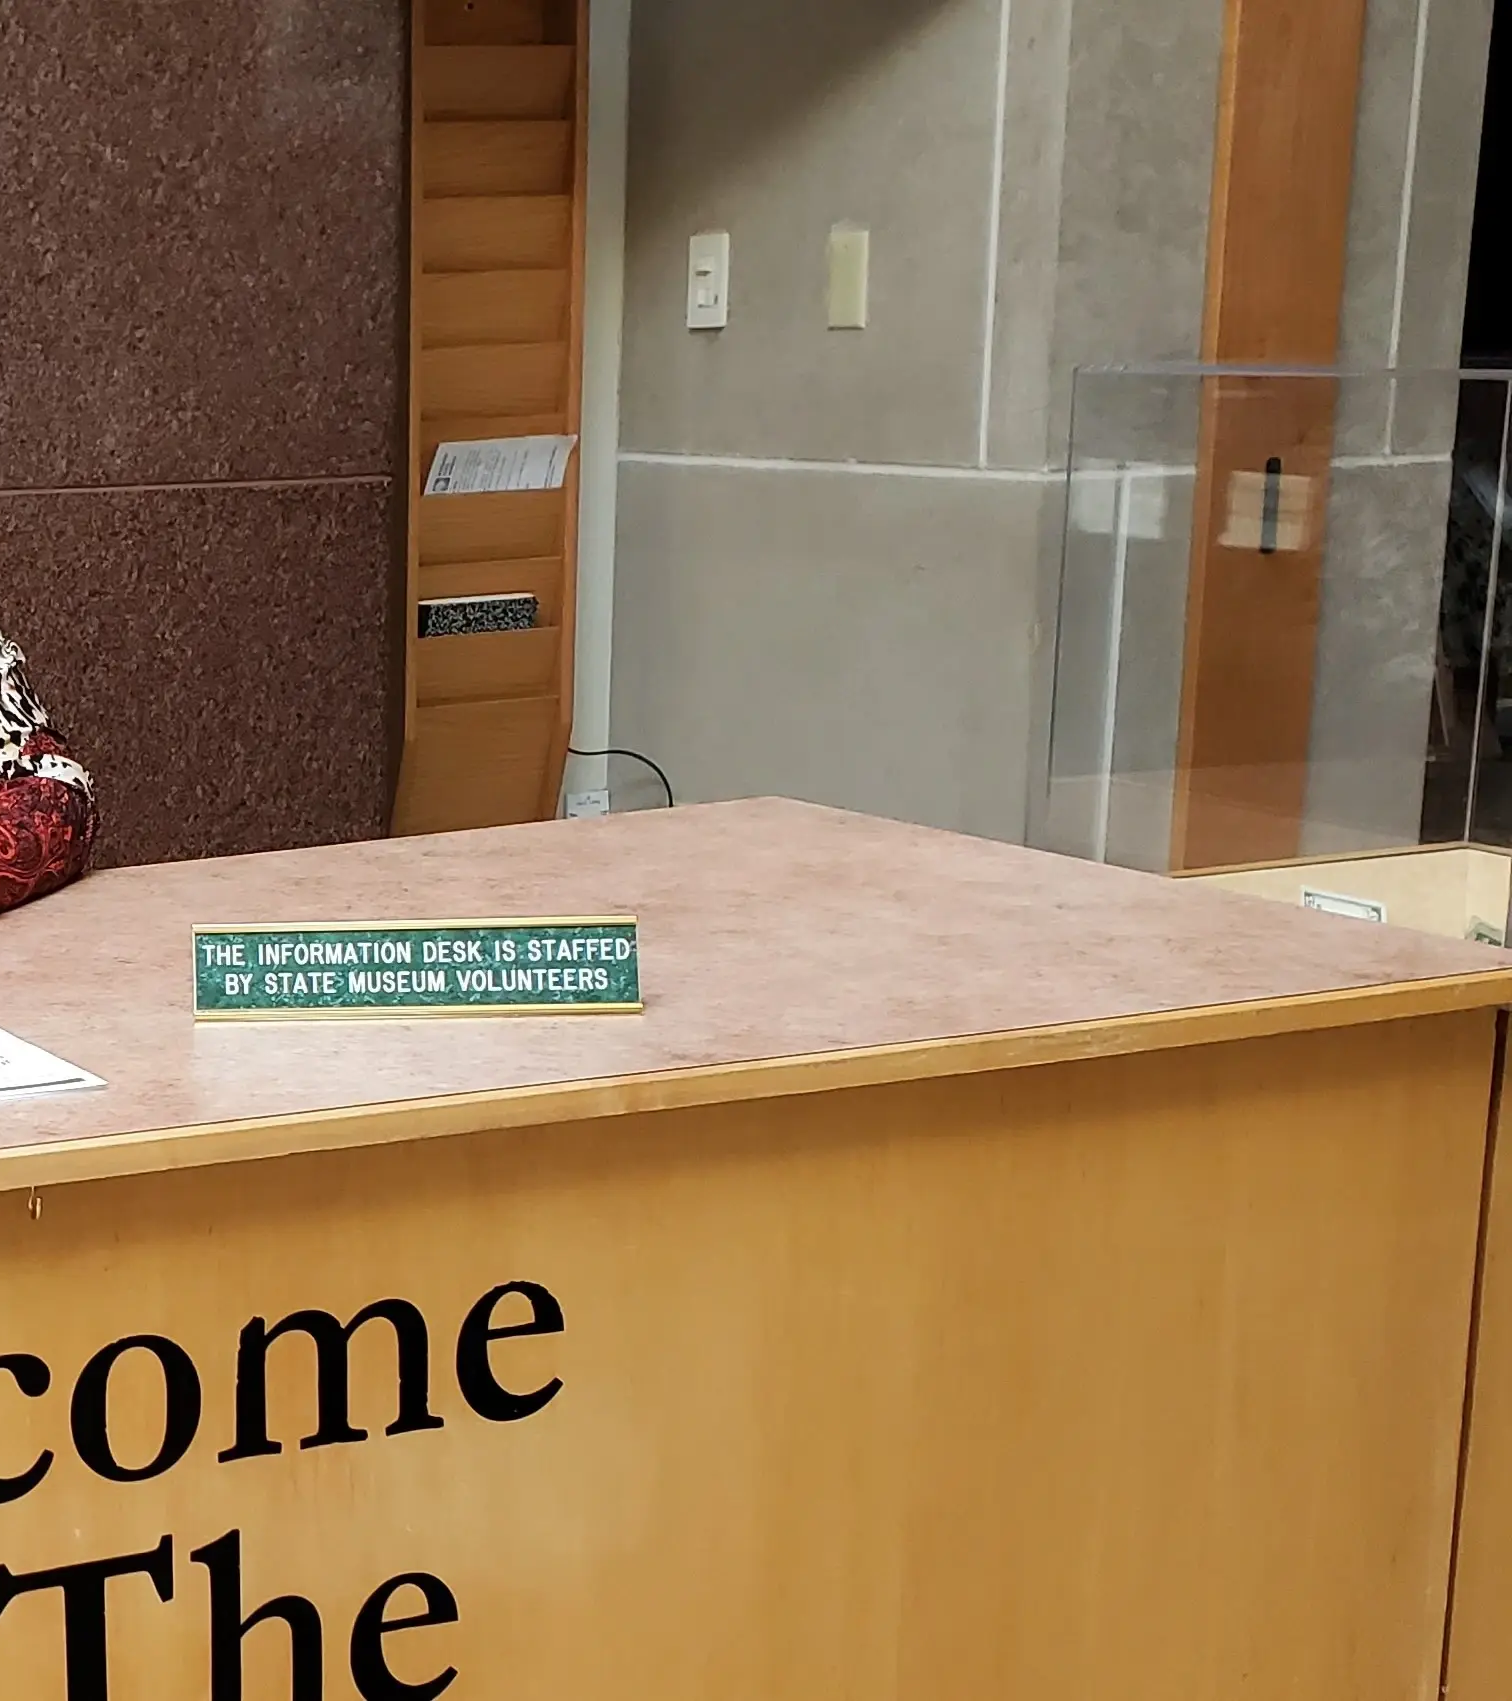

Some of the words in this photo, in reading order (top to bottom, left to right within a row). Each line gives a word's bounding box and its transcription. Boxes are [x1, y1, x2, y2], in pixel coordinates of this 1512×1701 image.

[201, 943, 246, 967] THE
[257, 941, 412, 966] INFORMATION
[422, 940, 483, 964] DESK
[495, 940, 516, 962] IS
[527, 937, 631, 962] STAFFED
[224, 973, 254, 996] BY
[263, 972, 336, 996] STATE
[347, 970, 446, 994] MUSEUM
[457, 968, 609, 993] VOLUNTEERS
